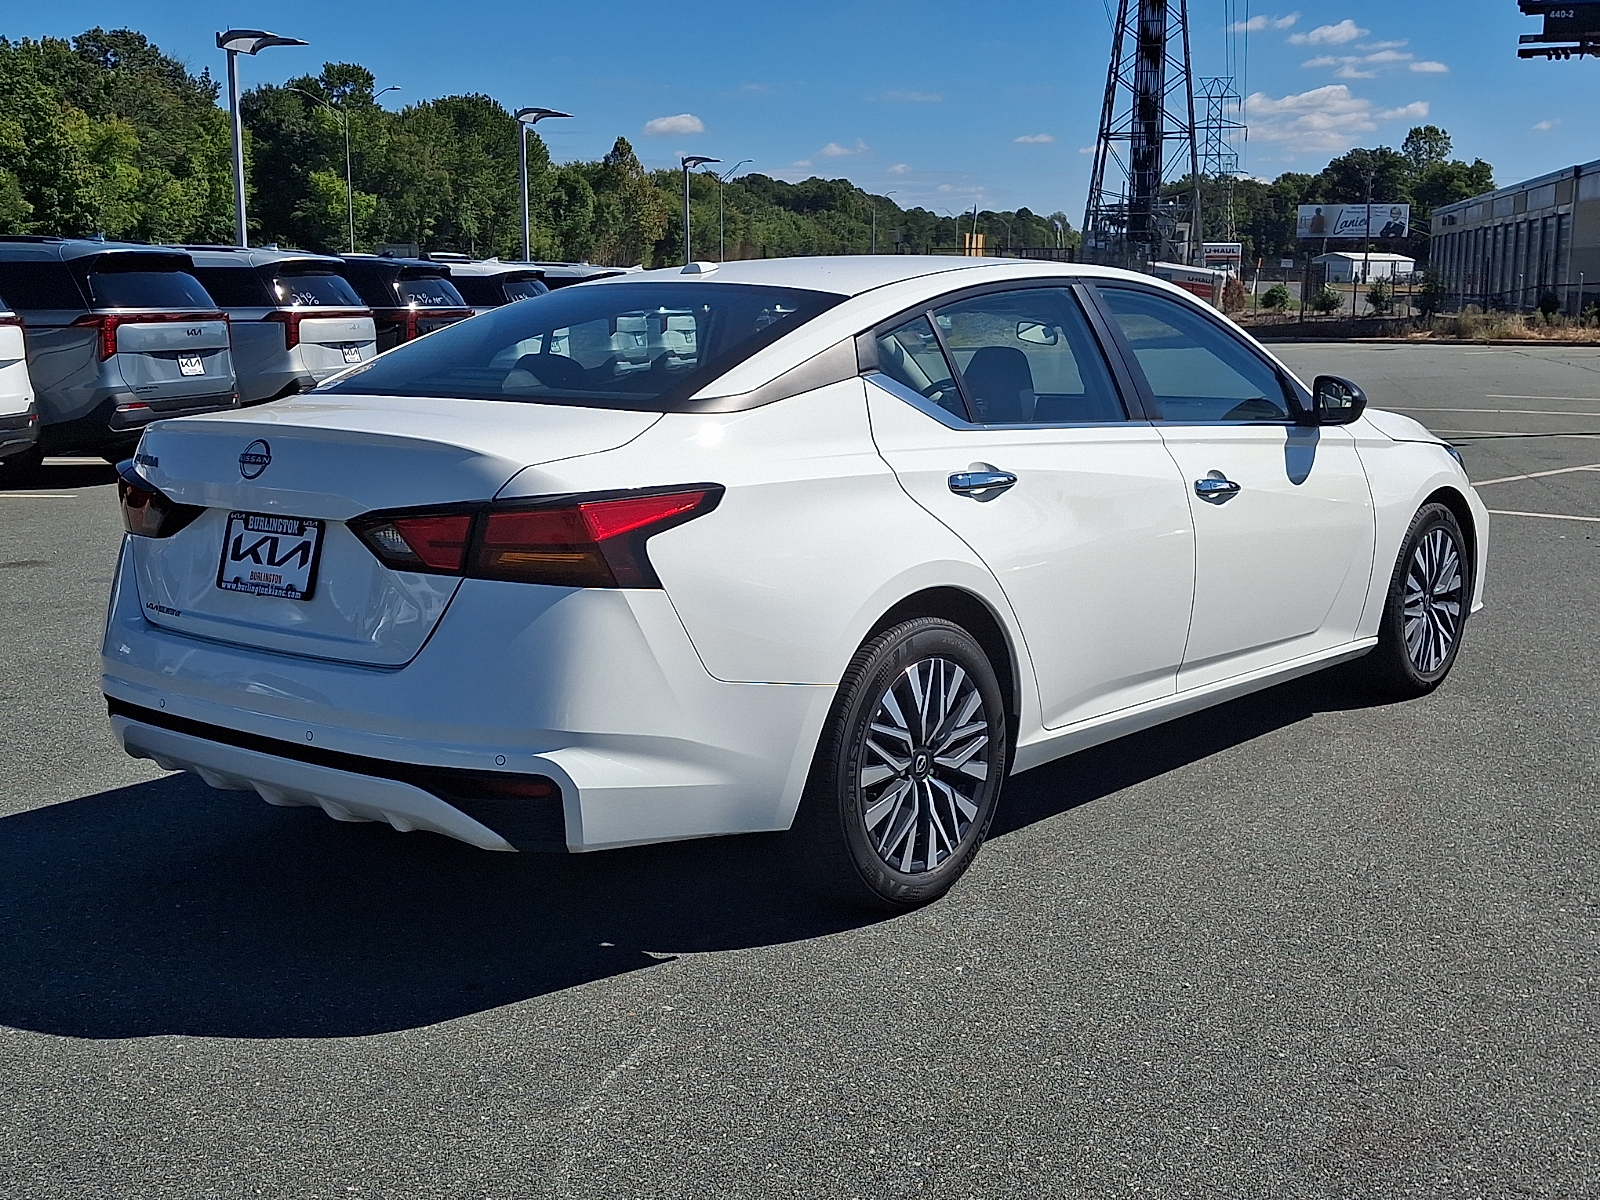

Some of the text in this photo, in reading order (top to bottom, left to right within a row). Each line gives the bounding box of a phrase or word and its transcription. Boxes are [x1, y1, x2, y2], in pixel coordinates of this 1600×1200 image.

[1549, 10, 1575, 18] 440-2
[1333, 209, 1373, 235] Lanie
[247, 515, 300, 534] BURLINGTON
[230, 532, 313, 571] KIA
[249, 570, 282, 584] BURLINGTON
